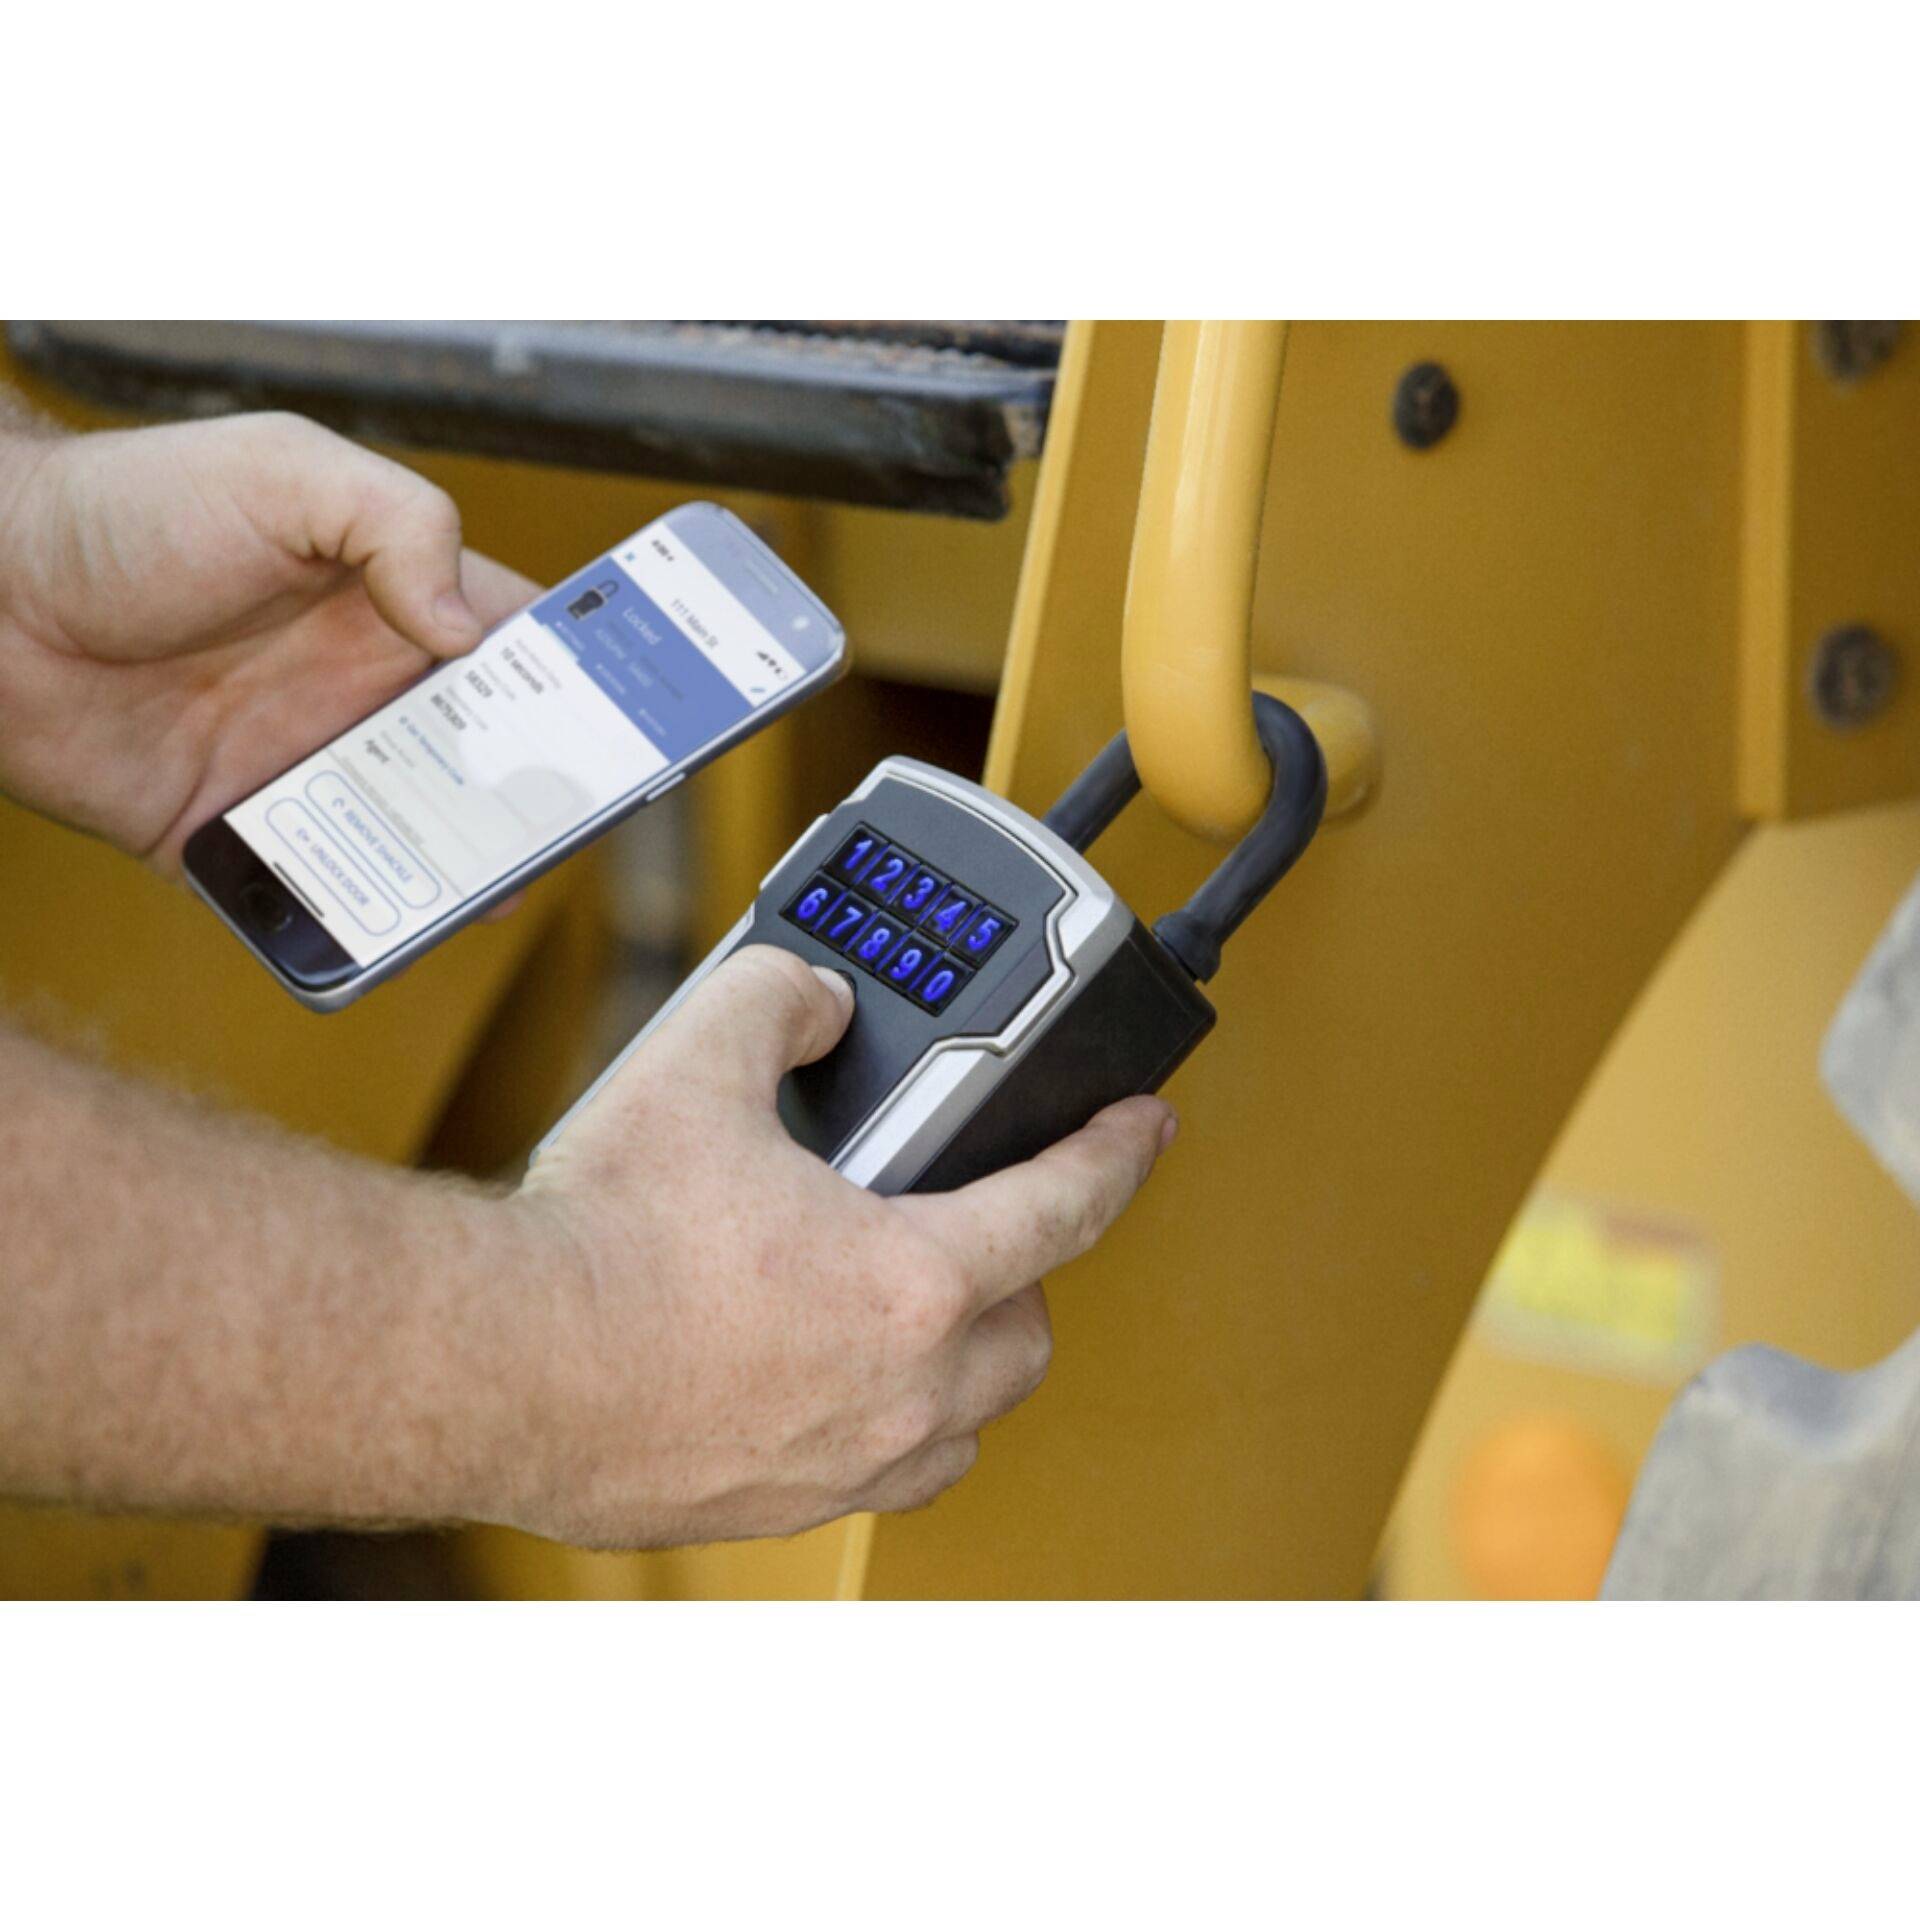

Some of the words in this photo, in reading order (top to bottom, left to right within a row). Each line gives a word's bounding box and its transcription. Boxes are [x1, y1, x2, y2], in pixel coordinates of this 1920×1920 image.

[622, 606, 662, 645] Locked
[686, 614, 709, 639] Main
[510, 659, 545, 694] seconds
[311, 844, 345, 880] UNLOCK
[341, 878, 370, 906] DOOR
[344, 809, 379, 846] REMOVE
[376, 844, 413, 883] SHACKLE
[845, 839, 873, 870] 1
[870, 858, 904, 891] 2
[902, 877, 935, 910] 3
[934, 900, 966, 931] 4
[967, 917, 1001, 950] 5
[797, 887, 828, 919] 6
[829, 906, 863, 938] 7
[858, 927, 890, 960] 8
[889, 949, 922, 980] 9
[922, 970, 954, 1001] 0
